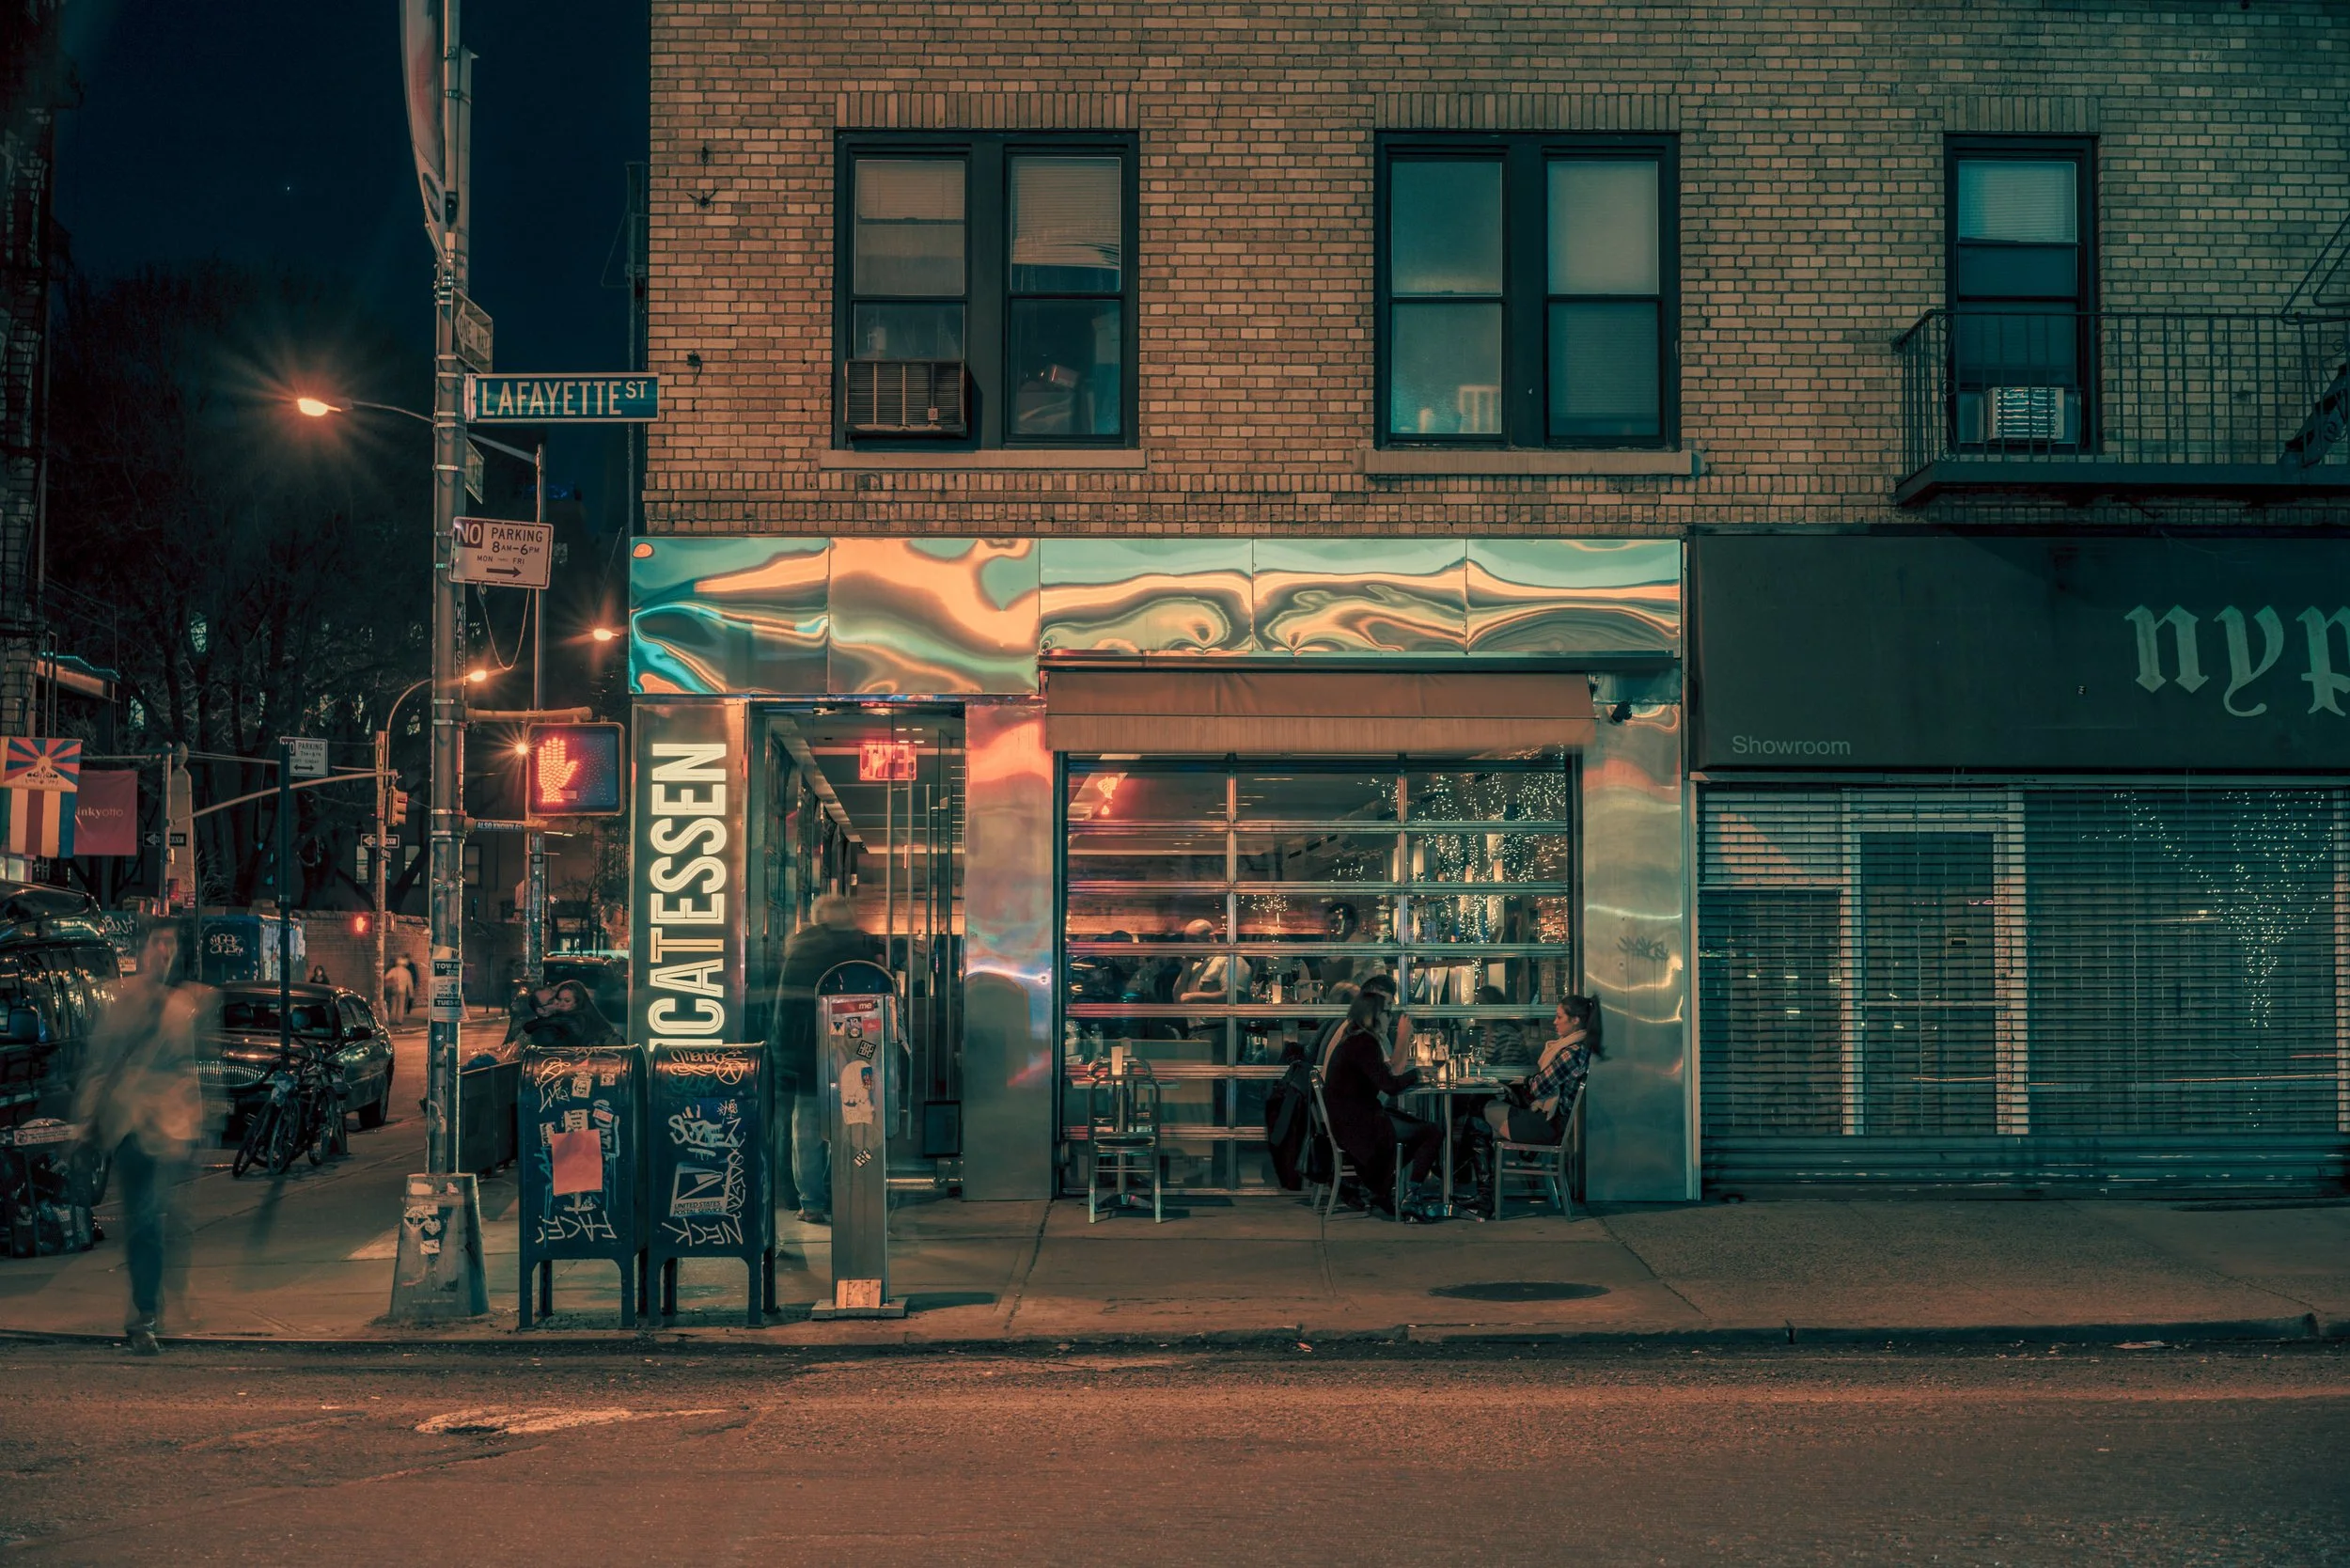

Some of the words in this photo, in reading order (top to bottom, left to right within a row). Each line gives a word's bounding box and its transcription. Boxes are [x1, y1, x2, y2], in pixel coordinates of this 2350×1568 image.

[482, 381, 622, 416] LAFAYETTE
[625, 381, 648, 400] ST
[456, 524, 482, 544] NO
[492, 527, 543, 542] PARKING
[297, 742, 323, 751] PARKING
[1731, 734, 1851, 756] Showroom
[76, 807, 124, 819] inkyotto
[477, 821, 493, 829] ALSO
[493, 823, 514, 831] KNOWN
[648, 744, 727, 1051] ICATESSEN
[662, 1216, 744, 1247] NECK
